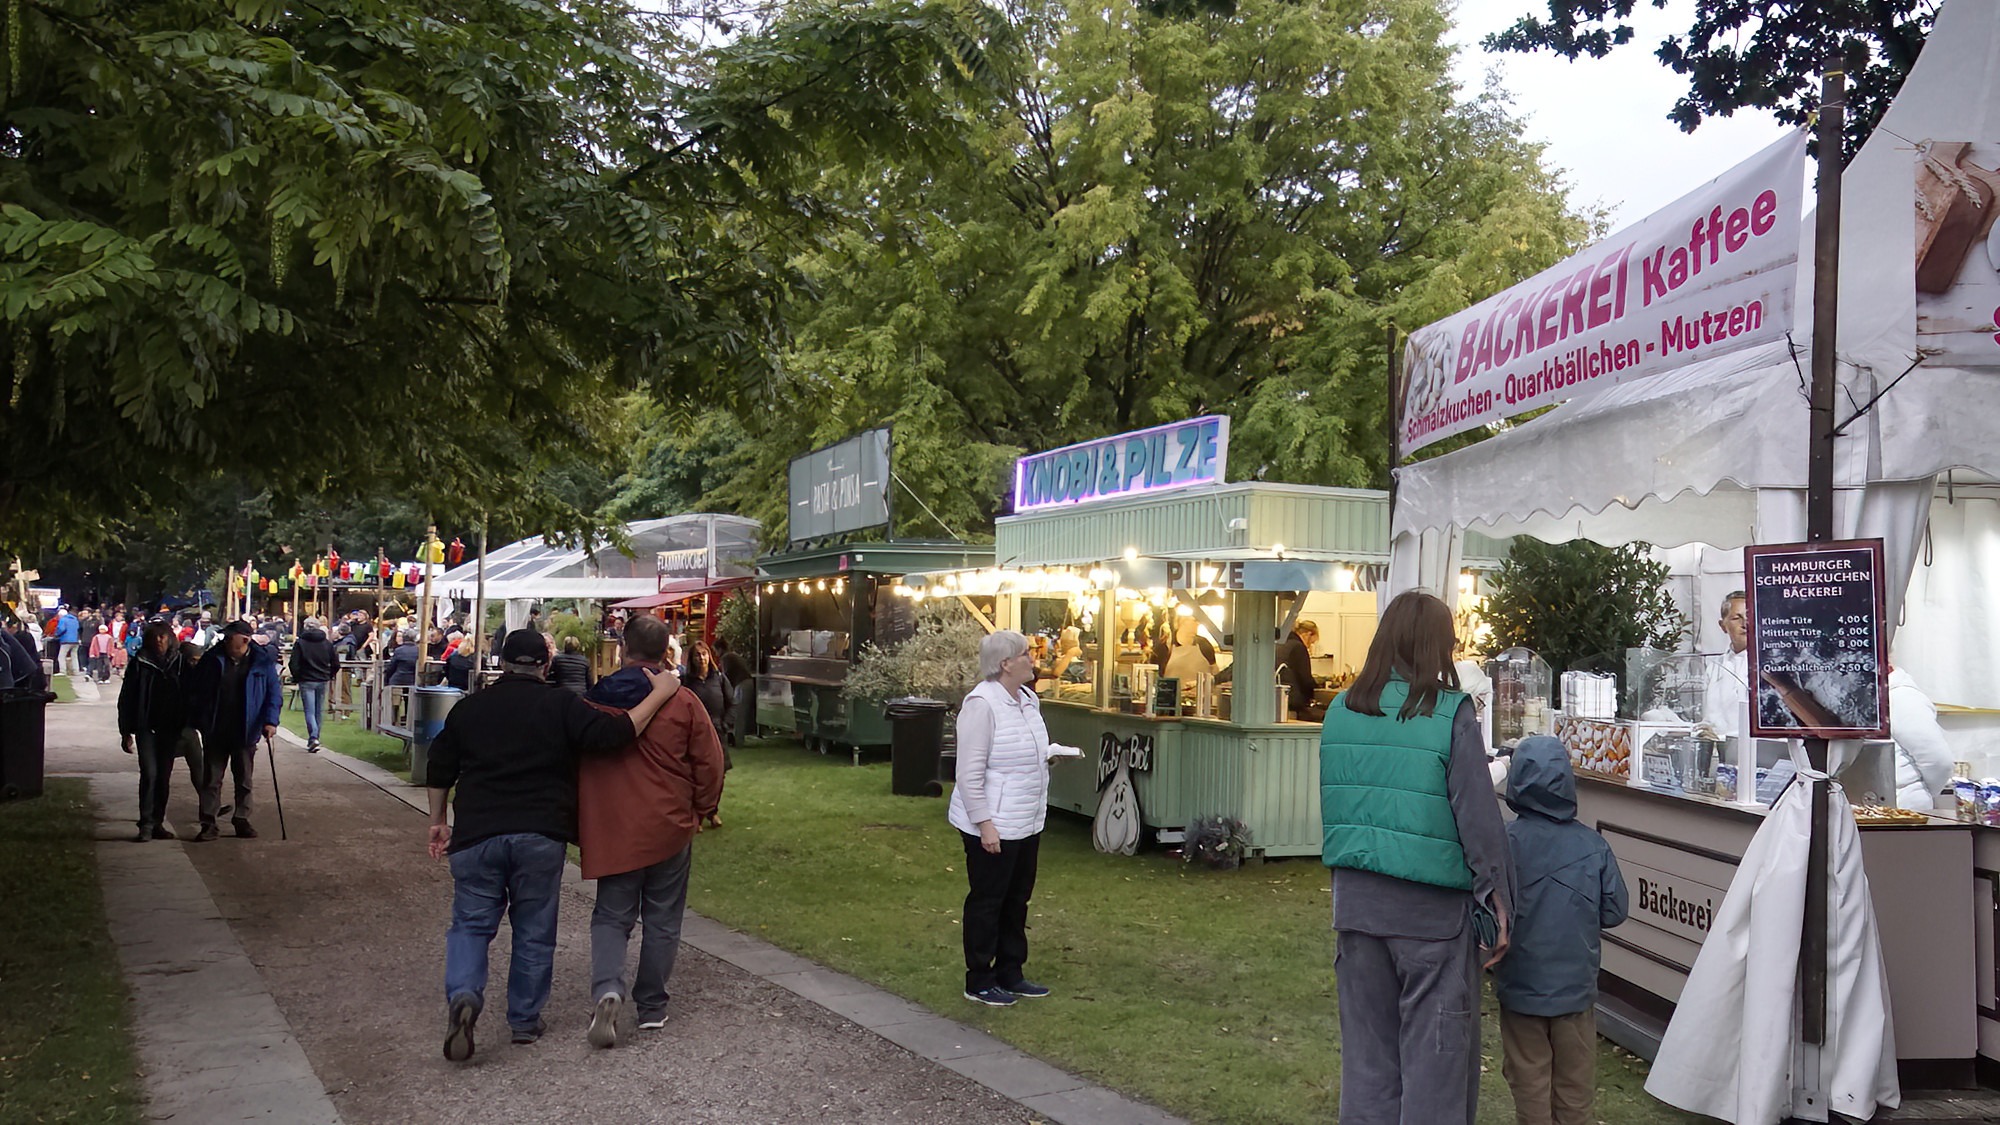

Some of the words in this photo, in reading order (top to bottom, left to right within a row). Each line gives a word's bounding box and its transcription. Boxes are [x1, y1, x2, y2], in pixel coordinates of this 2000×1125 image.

[1454, 240, 1638, 385] BÄCKEREI
[1642, 189, 1777, 307] Kaffee
[1407, 388, 1492, 444] Schmalzkuchen
[1505, 339, 1640, 406] Quarkbällchen
[1661, 301, 1762, 357] Mutzen
[1772, 560, 1851, 572] HAMBURGER
[1167, 561, 1244, 589] PILZE
[1757, 571, 1870, 586] SCHMALZKUCHEN
[1783, 586, 1842, 598] BÄCKEREI
[1761, 617, 1790, 625] Kleine
[1791, 616, 1812, 625] Tüte
[1762, 628, 1799, 637] Mittlere
[1801, 628, 1822, 637] Tüte
[1762, 641, 1792, 651] Jumbo
[1794, 640, 1815, 649] Tüte
[1095, 736, 1122, 792] Knobi
[1638, 877, 1713, 933] Bäckerei
